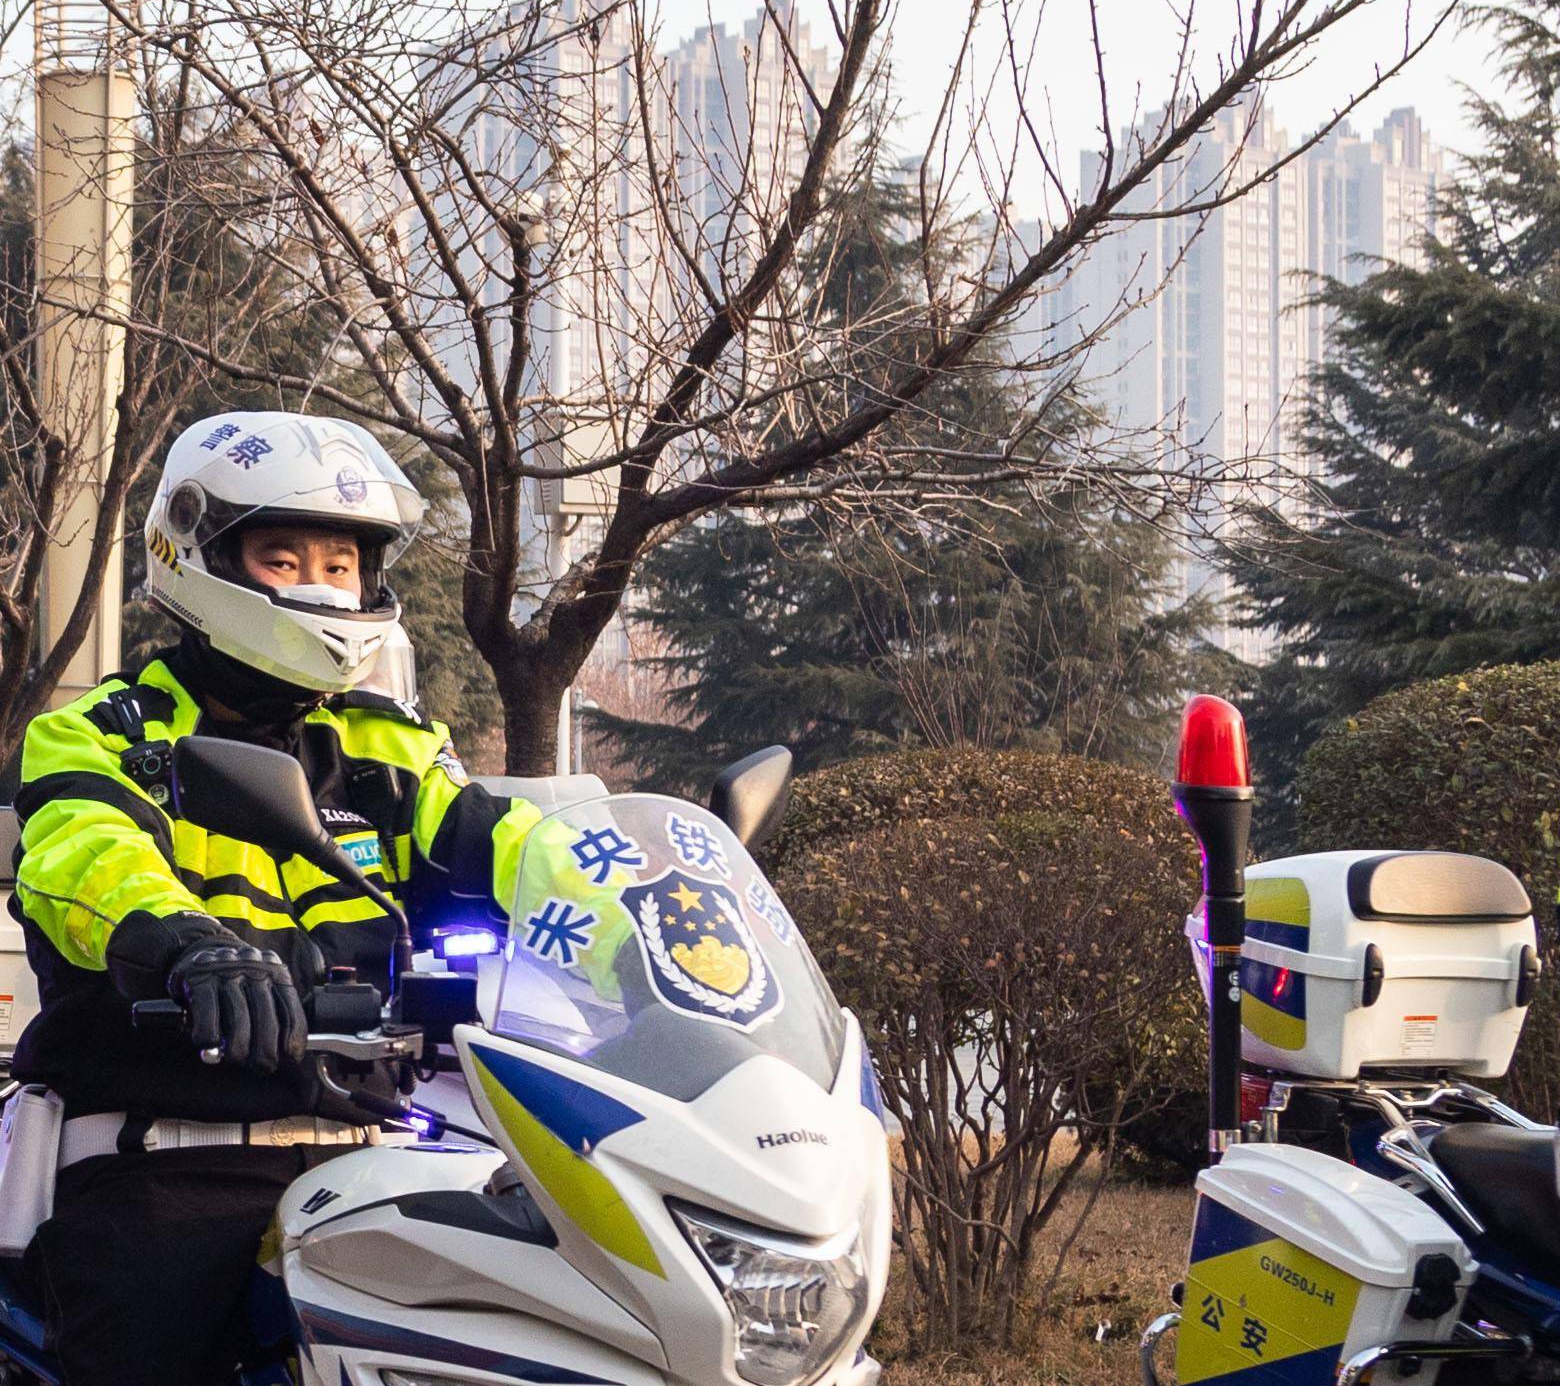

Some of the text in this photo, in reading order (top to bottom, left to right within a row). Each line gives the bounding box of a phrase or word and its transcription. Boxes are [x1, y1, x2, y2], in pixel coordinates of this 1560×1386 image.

[200, 423, 274, 470] 警察
[1261, 1255, 1336, 1307] GW250J-H
[1201, 1294, 1268, 1357] 公安
